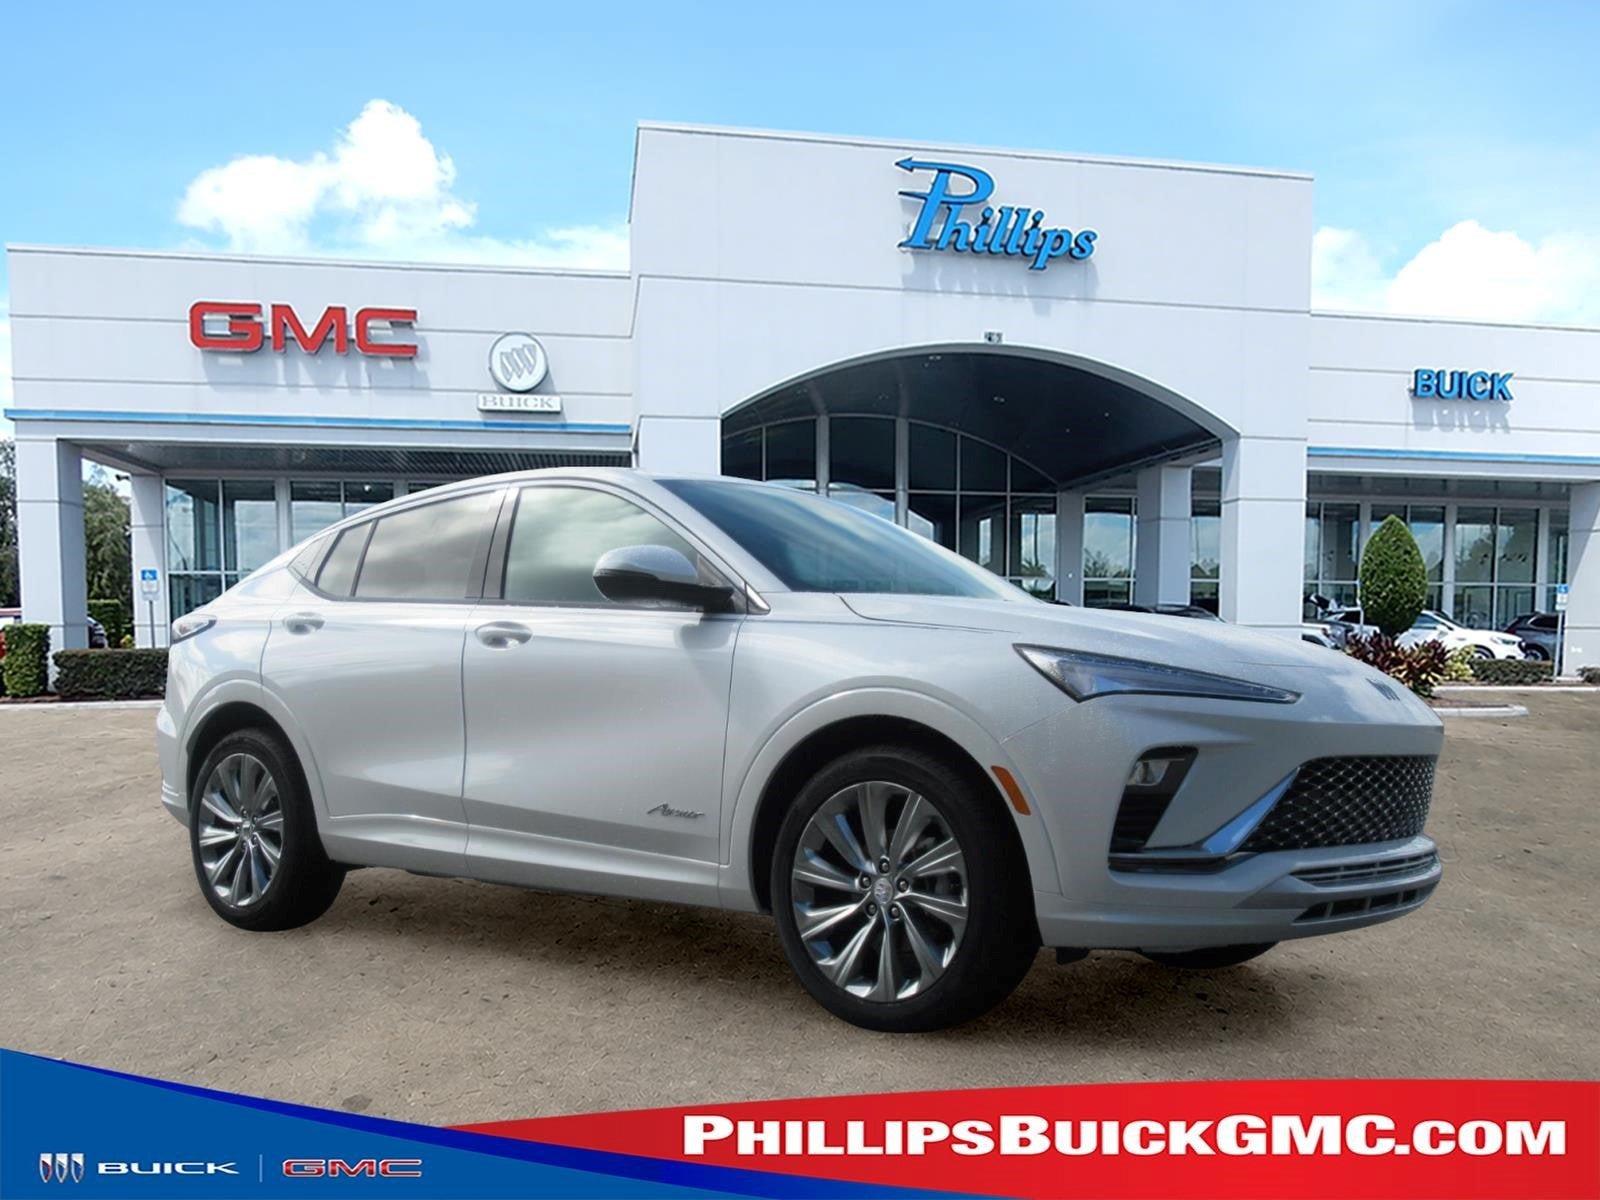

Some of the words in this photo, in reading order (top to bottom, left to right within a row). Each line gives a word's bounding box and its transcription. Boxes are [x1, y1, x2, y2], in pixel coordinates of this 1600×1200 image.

[895, 156, 1098, 270] Phillips
[189, 300, 418, 358] GMC
[481, 395, 554, 409] BUICK
[1413, 368, 1514, 401] BUICK
